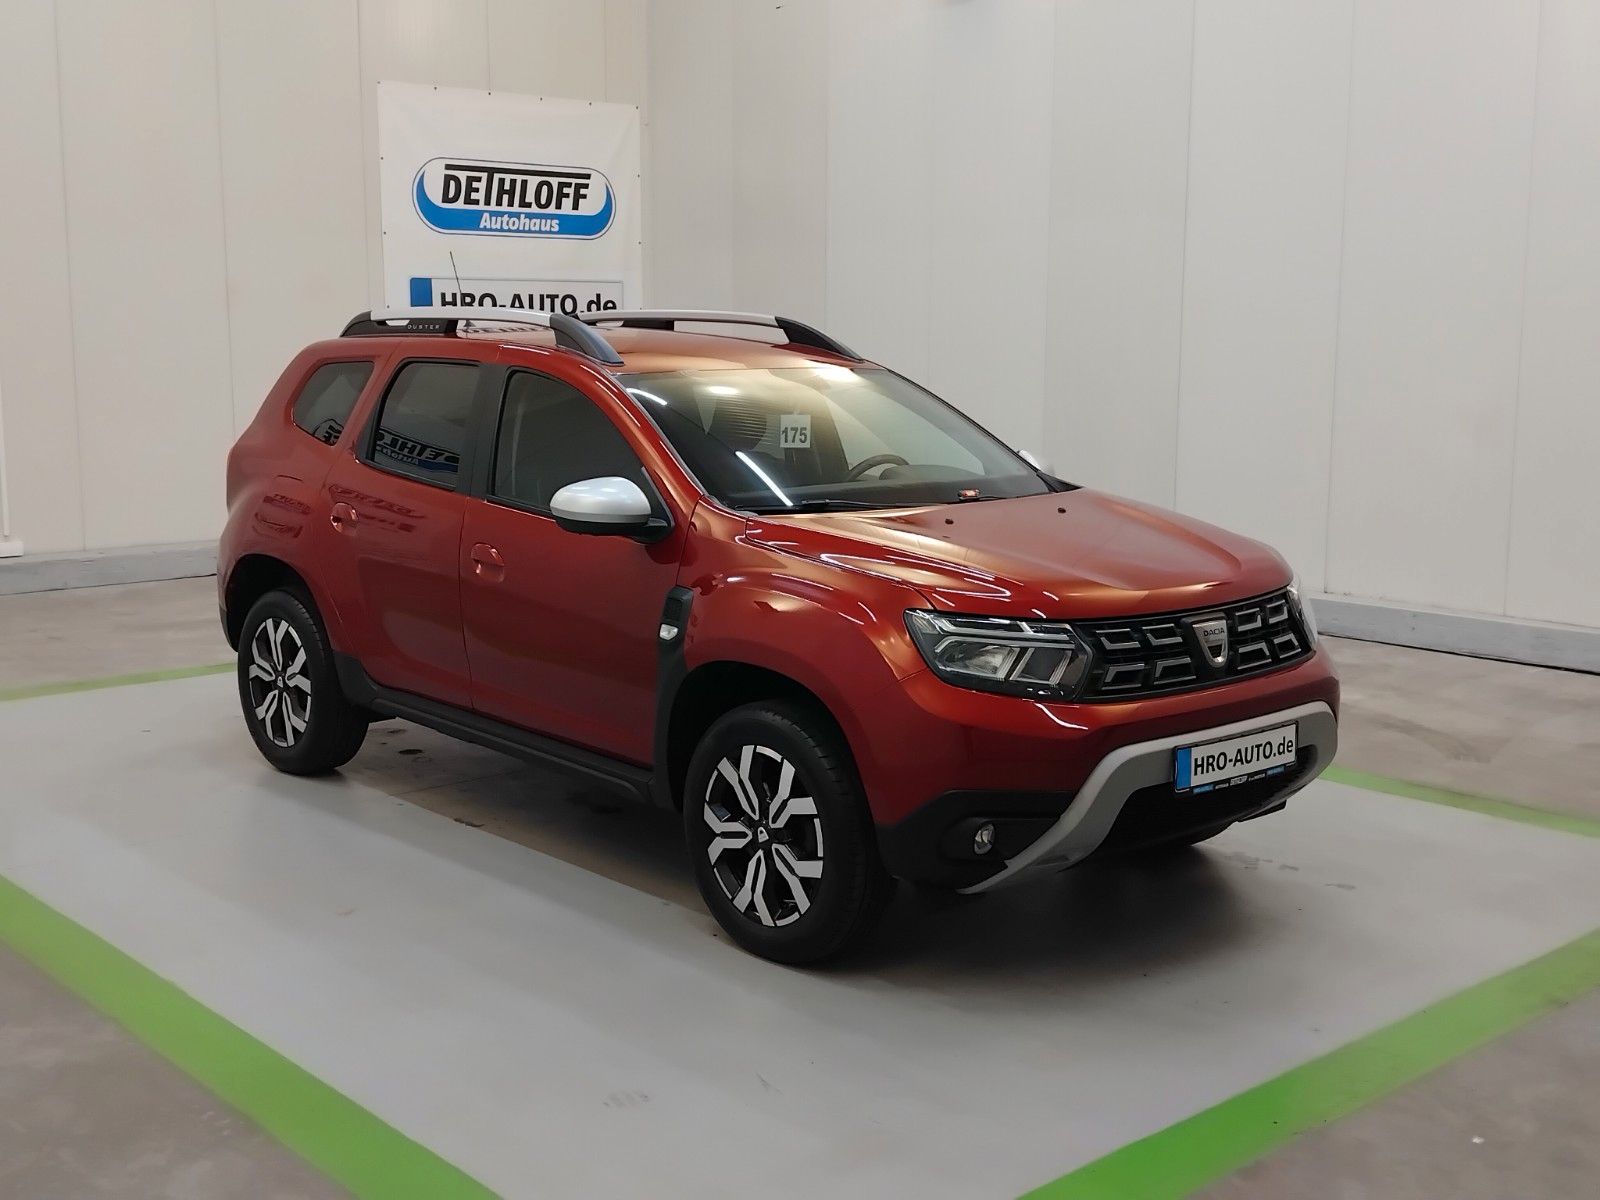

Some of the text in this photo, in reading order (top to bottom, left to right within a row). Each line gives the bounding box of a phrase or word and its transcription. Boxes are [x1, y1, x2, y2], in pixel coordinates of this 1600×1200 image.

[441, 163, 591, 211] DETHLOFF
[479, 212, 559, 232] Autohaus
[781, 426, 807, 443] 175
[1203, 627, 1225, 637] DACIA
[1193, 736, 1294, 776] HRO-AUTO.de
